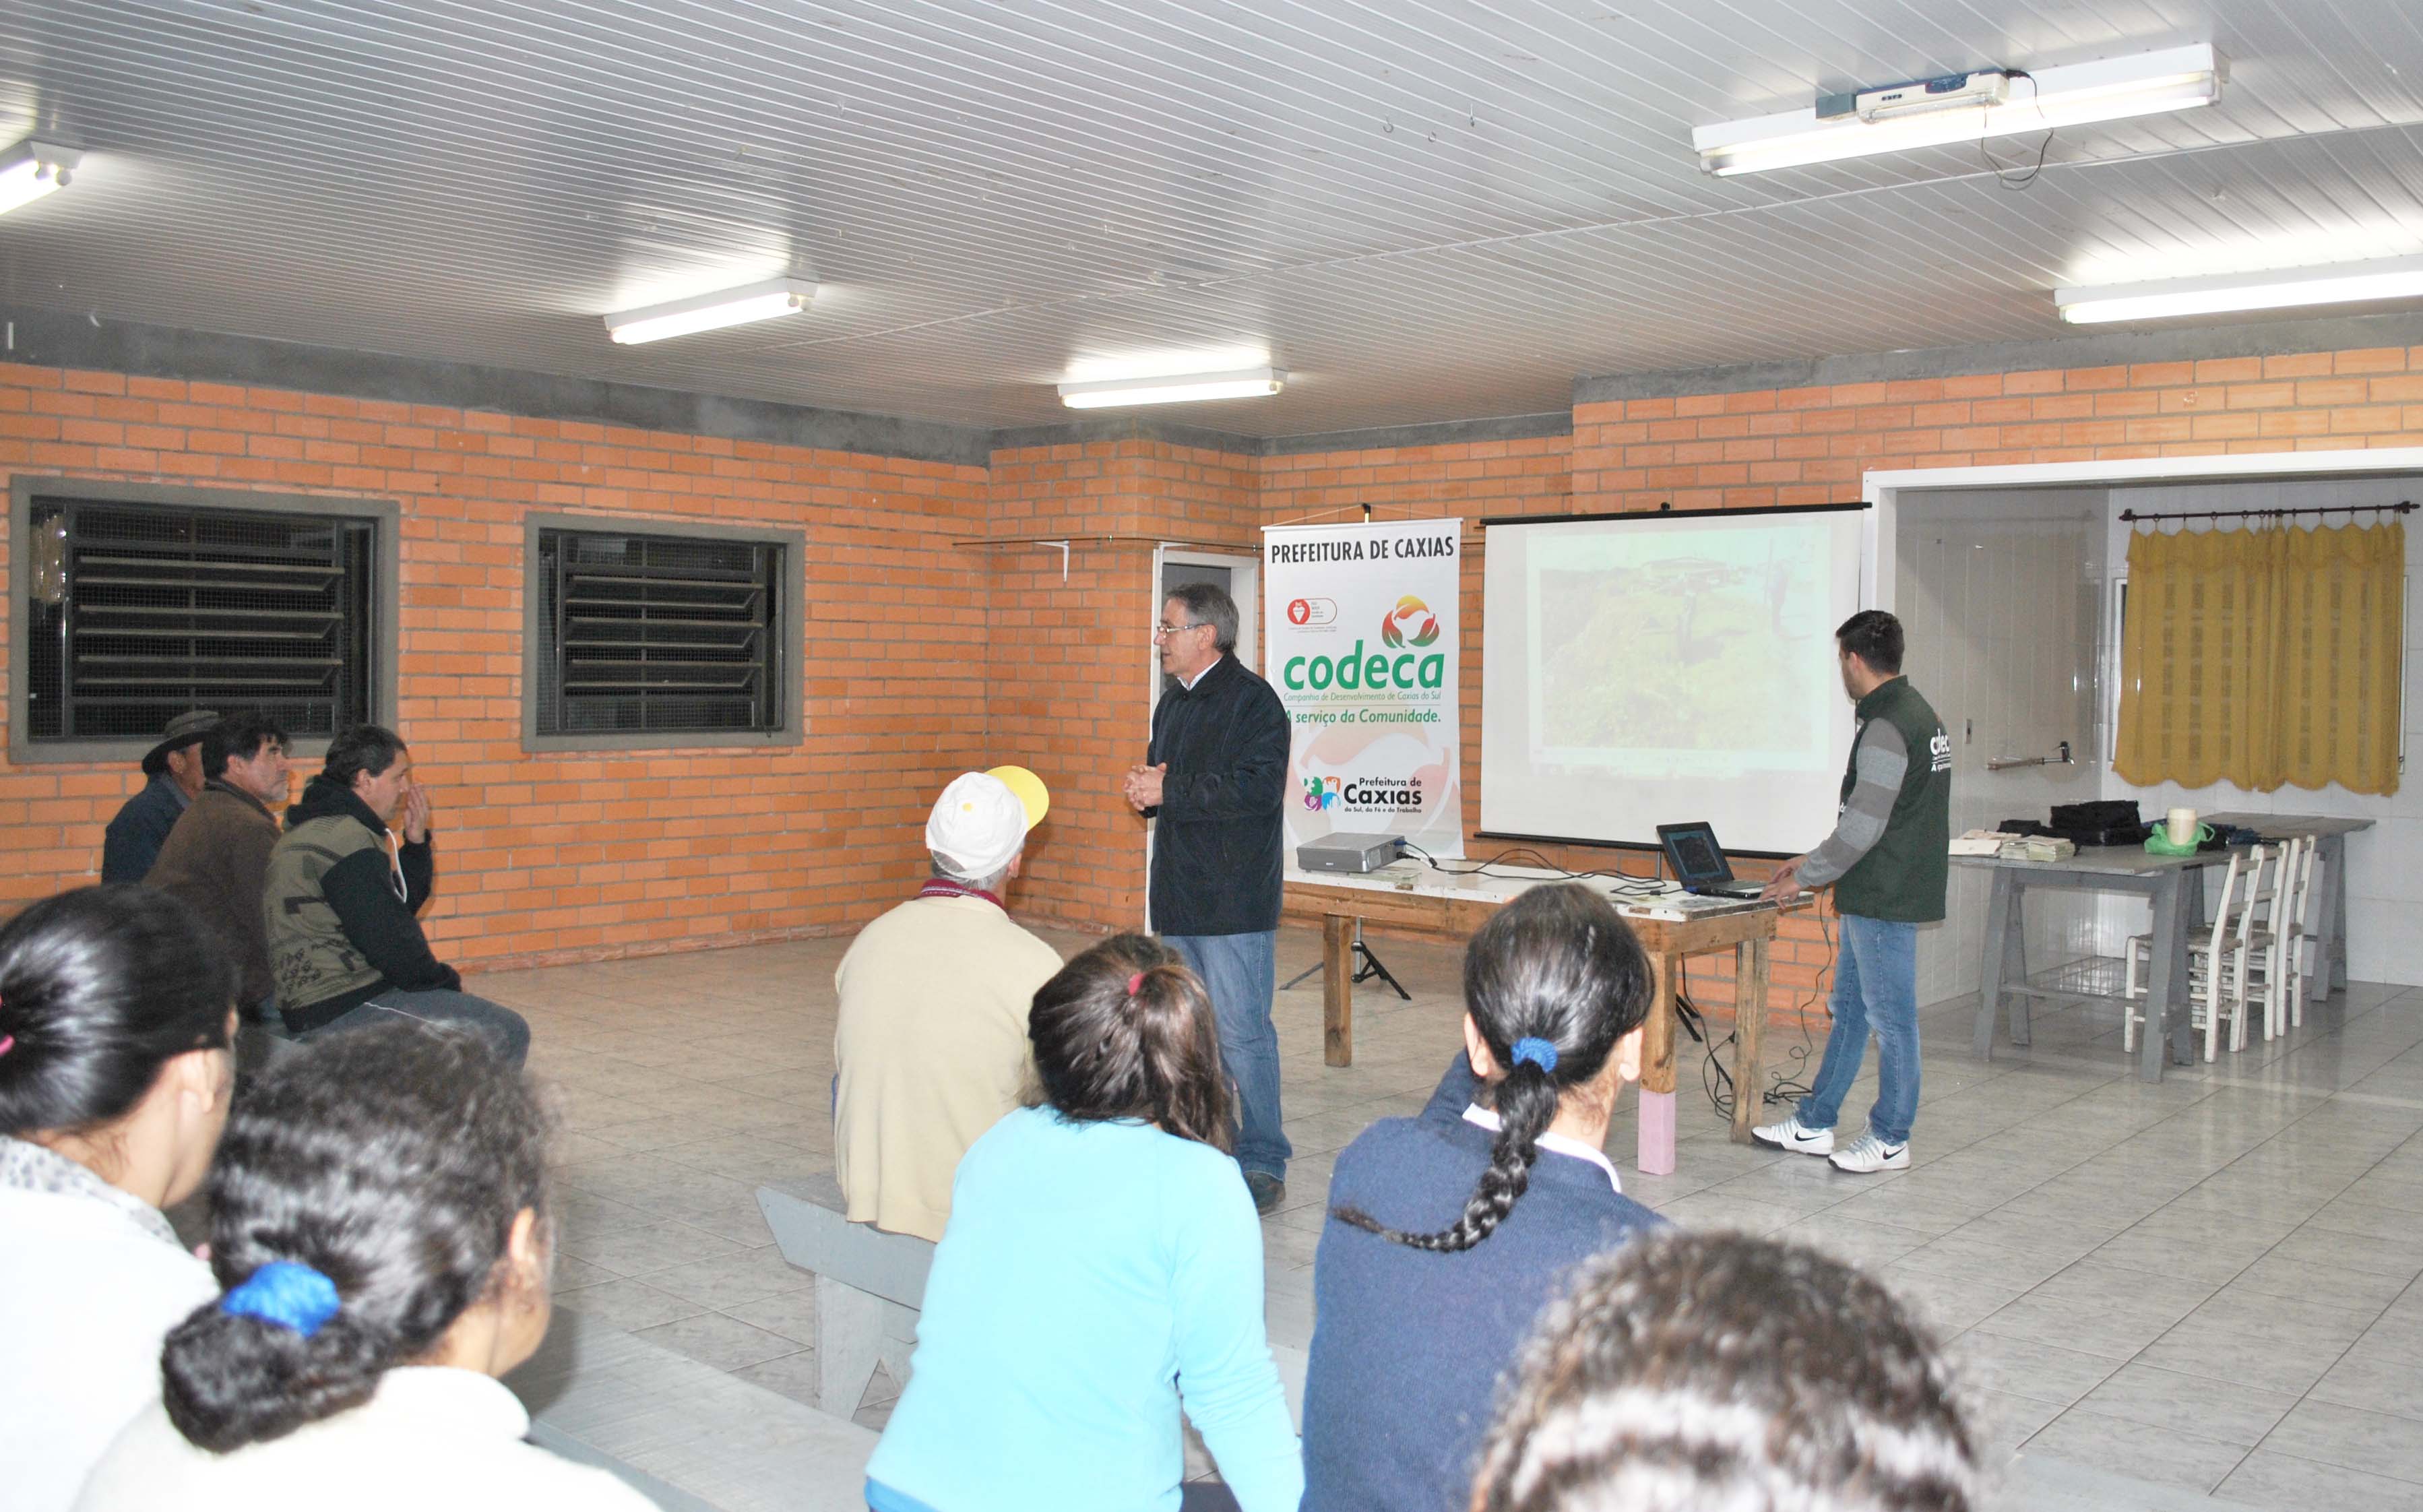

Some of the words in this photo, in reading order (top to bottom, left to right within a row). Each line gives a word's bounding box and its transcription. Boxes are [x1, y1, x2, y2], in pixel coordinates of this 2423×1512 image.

[1271, 540, 1364, 563] PREFEITURA
[1370, 540, 1389, 559] DE
[1394, 536, 1454, 558] CAXIAS
[1284, 639, 1445, 691] codeca
[1284, 693, 1319, 703] Companhia
[1331, 692, 1385, 701] Desenvolvimento
[1387, 691, 1395, 700] de
[1397, 691, 1419, 700] Caxias
[1420, 691, 1429, 700] do
[1431, 691, 1441, 700] Sul
[1296, 710, 1336, 727] serviço
[1340, 709, 1355, 722] da
[1359, 708, 1441, 722] Comunidade.
[1360, 777, 1407, 786] Prefeitura
[1410, 778, 1422, 786] de
[1344, 784, 1422, 805] Caxias
